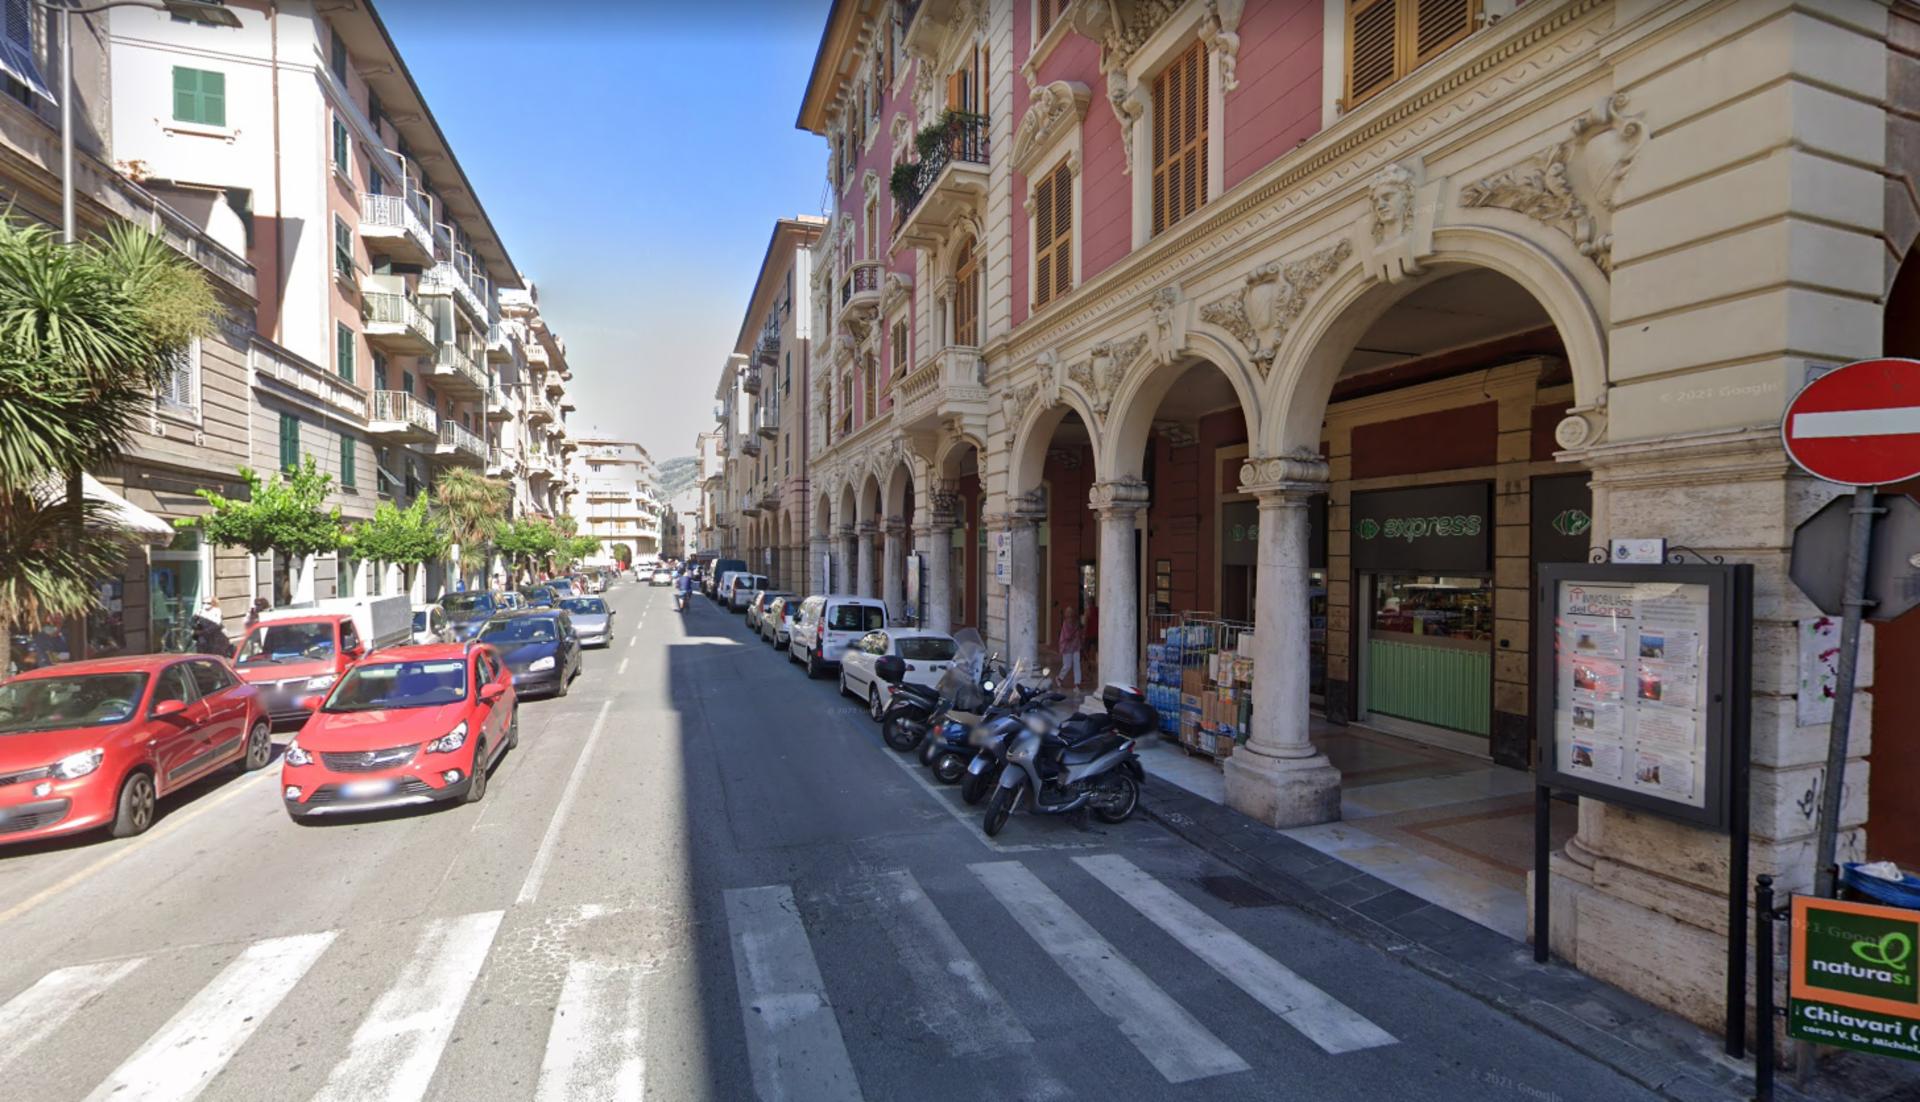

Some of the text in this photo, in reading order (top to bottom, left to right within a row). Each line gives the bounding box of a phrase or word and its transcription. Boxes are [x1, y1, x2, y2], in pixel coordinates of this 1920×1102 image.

[1383, 514, 1482, 543] express
[1802, 1024, 1835, 1037] corso
[1851, 1033, 1870, 1044] De
[1803, 1006, 1903, 1036] Chiavari
